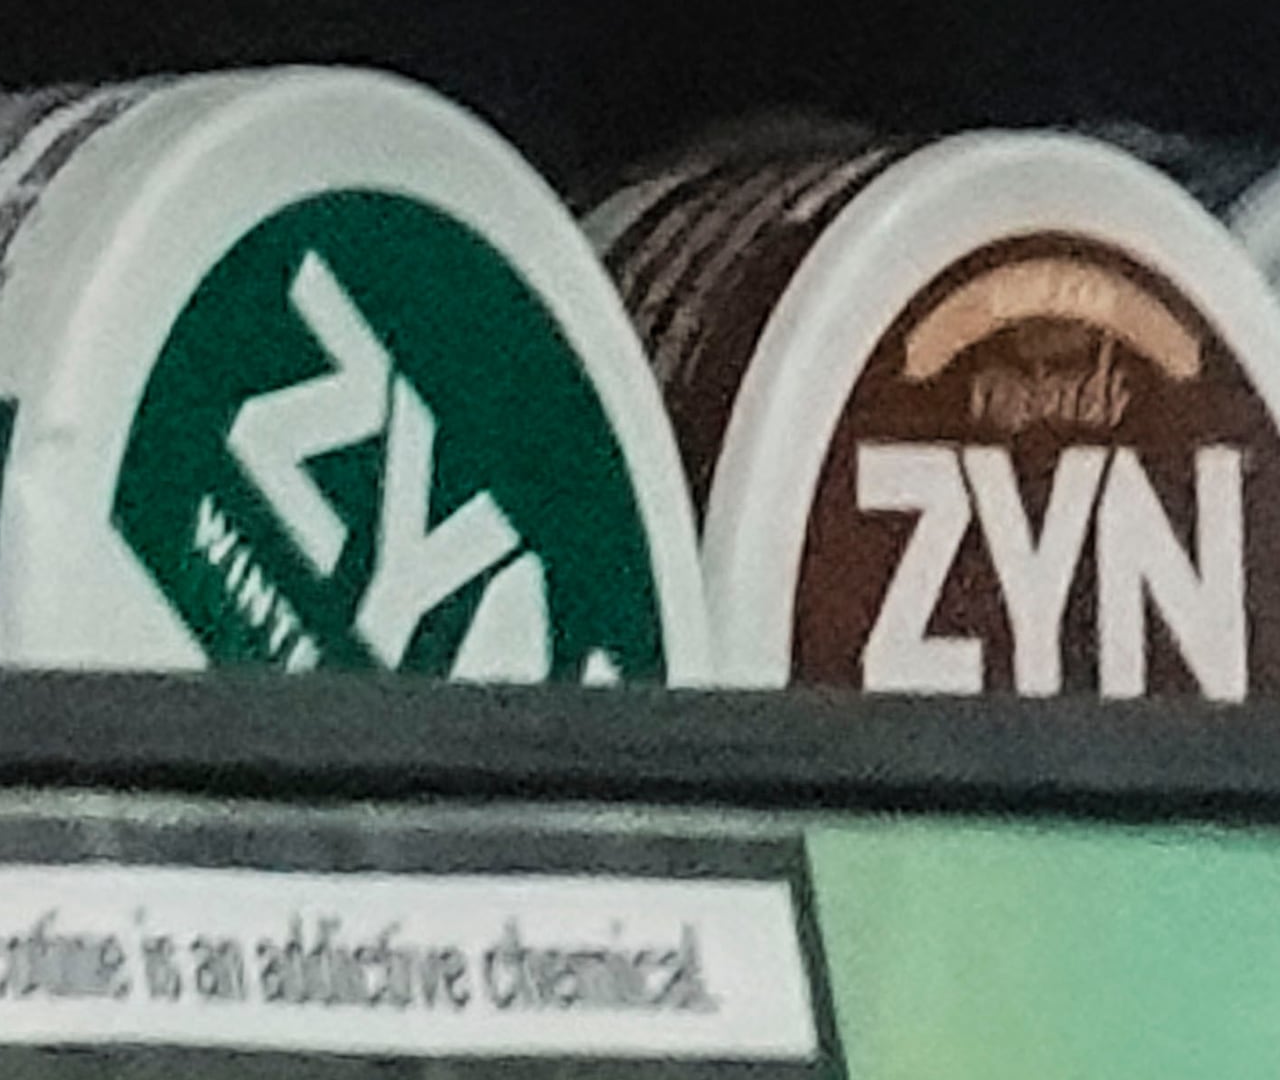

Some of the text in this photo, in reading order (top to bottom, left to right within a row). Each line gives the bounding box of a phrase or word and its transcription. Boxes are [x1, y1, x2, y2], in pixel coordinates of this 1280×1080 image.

[856, 444, 1249, 703] ZYN
[133, 906, 184, 998] is
[189, 934, 245, 1000] an
[253, 914, 470, 1010] addictive
